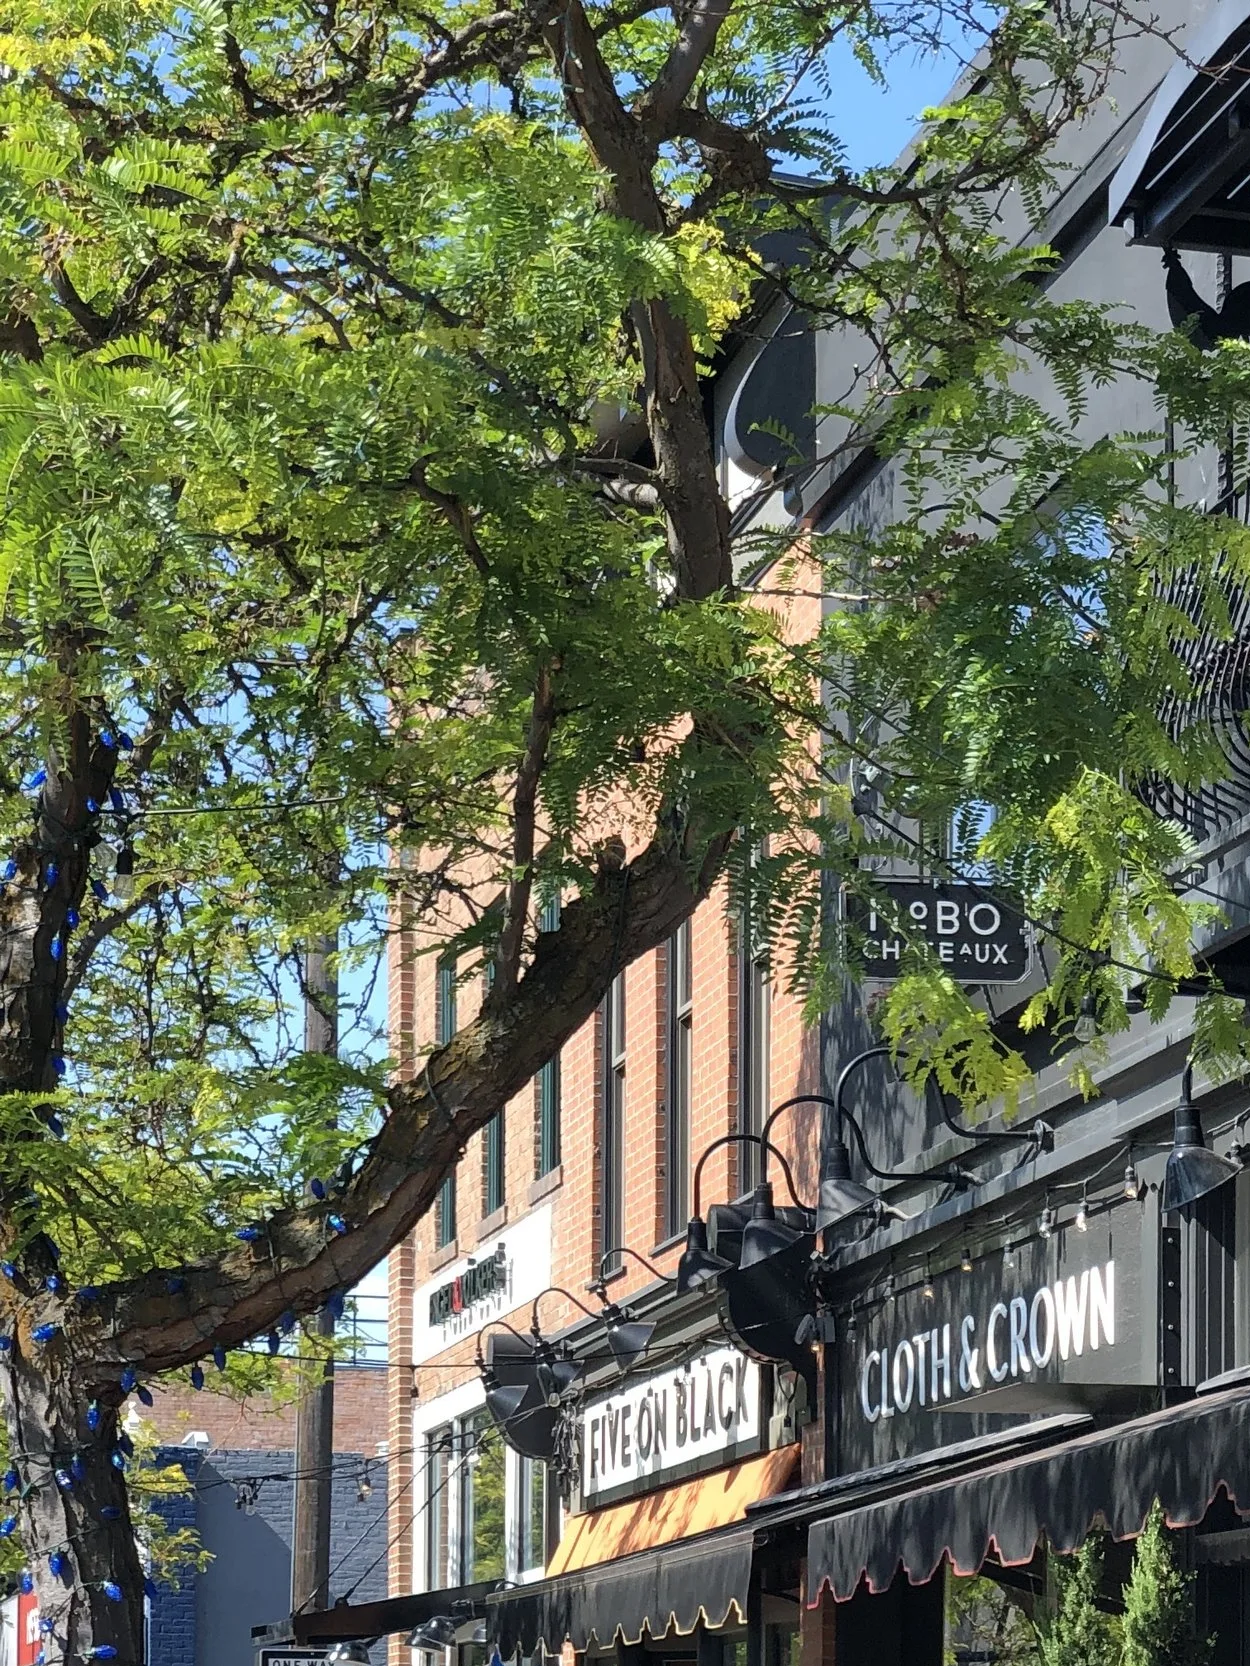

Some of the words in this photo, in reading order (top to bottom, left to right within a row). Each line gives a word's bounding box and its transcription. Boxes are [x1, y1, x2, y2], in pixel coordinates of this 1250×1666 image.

[862, 939, 1009, 965] CHTEAUX
[861, 1323, 951, 1423] CLOTH
[959, 1315, 981, 1393] &
[986, 1260, 1115, 1383] CROWN
[590, 1402, 632, 1480] FIVE
[638, 1388, 667, 1462] ON
[675, 1356, 749, 1449] BLACK
